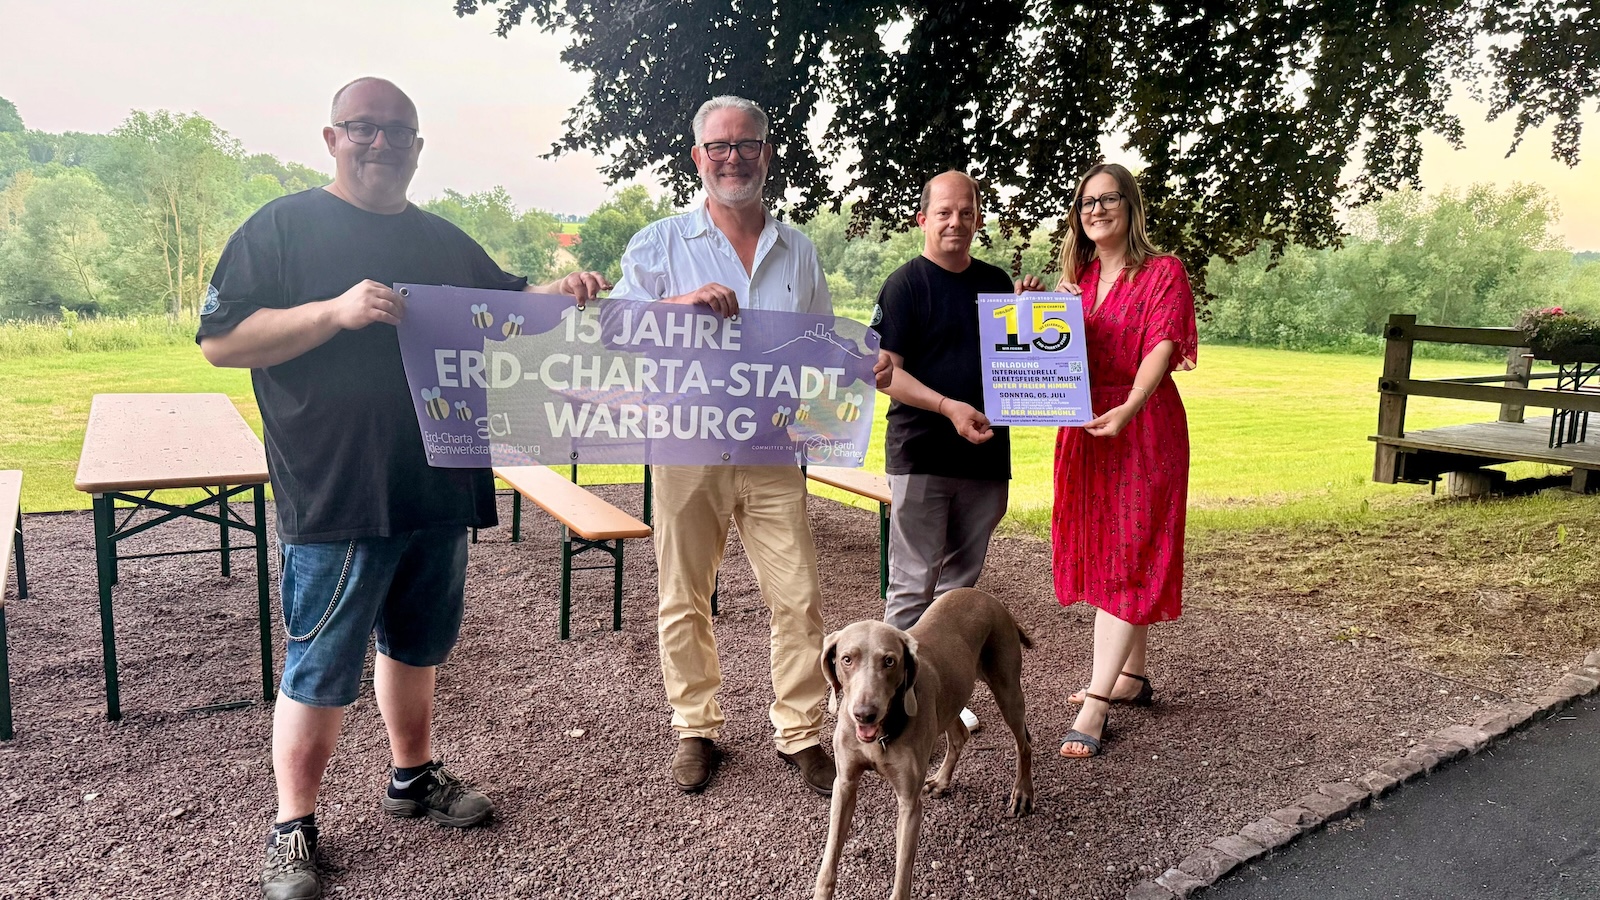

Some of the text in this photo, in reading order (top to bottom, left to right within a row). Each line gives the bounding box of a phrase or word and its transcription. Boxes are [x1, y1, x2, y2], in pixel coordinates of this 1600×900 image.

[561, 304, 742, 351] 15 JAHRE
[991, 361, 1039, 369] EINLADUNG
[435, 349, 845, 400] ERD-CHARTA-STADT
[544, 402, 757, 441] WARBURG
[424, 431, 473, 444] Erd-Charta
[427, 442, 541, 456] Ideenwerkstat Warburg
[834, 440, 855, 450] Earth
[833, 448, 863, 458] Charter
